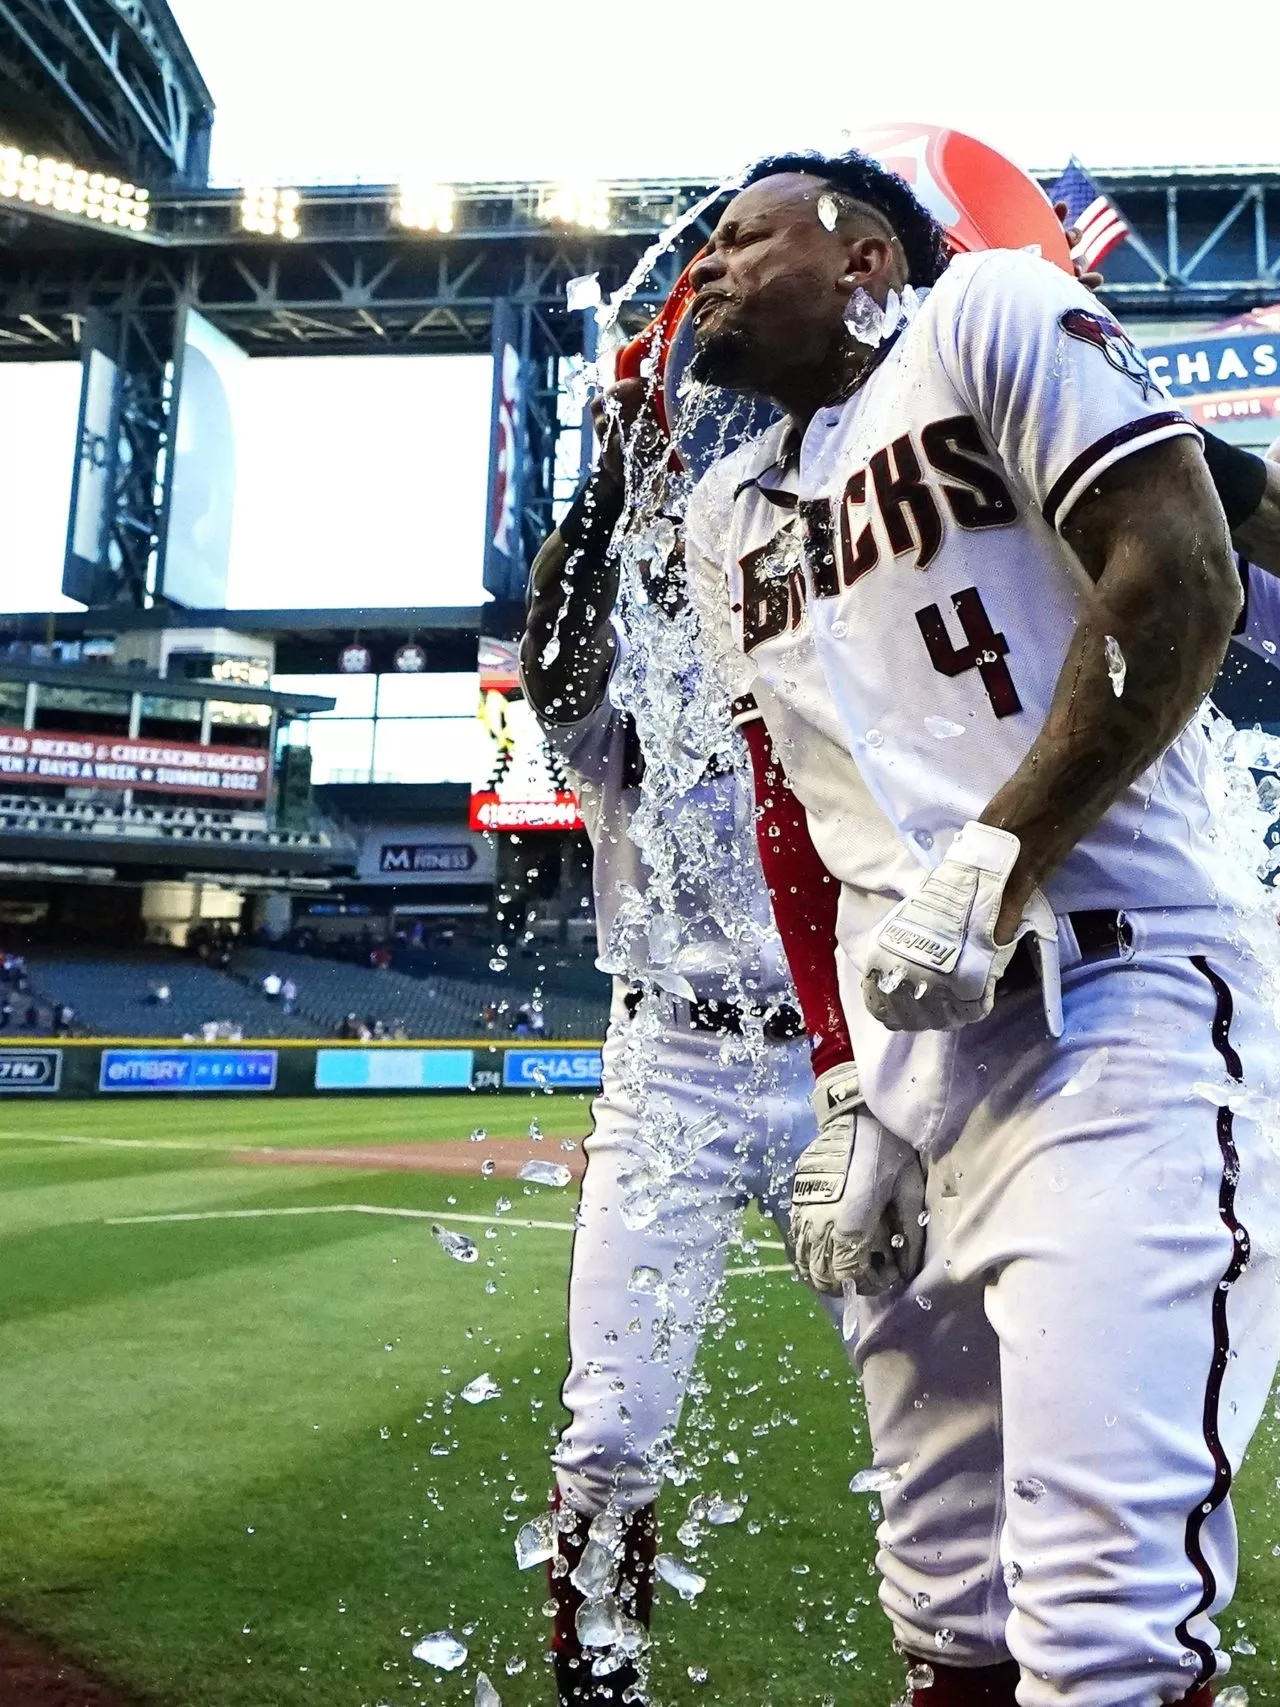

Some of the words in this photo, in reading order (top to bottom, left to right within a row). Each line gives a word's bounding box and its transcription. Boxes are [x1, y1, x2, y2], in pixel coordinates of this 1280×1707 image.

[1203, 400, 1262, 419] HOME
[914, 586, 1024, 720] 4
[27, 757, 38, 773] 7
[39, 759, 80, 778] DAYS
[81, 762, 94, 778] A
[95, 763, 138, 781] WEEK
[156, 767, 220, 788] SUMMER
[383, 849, 410, 870] M
[521, 1057, 605, 1079] CHASE
[794, 1175, 842, 1199] Franklin
